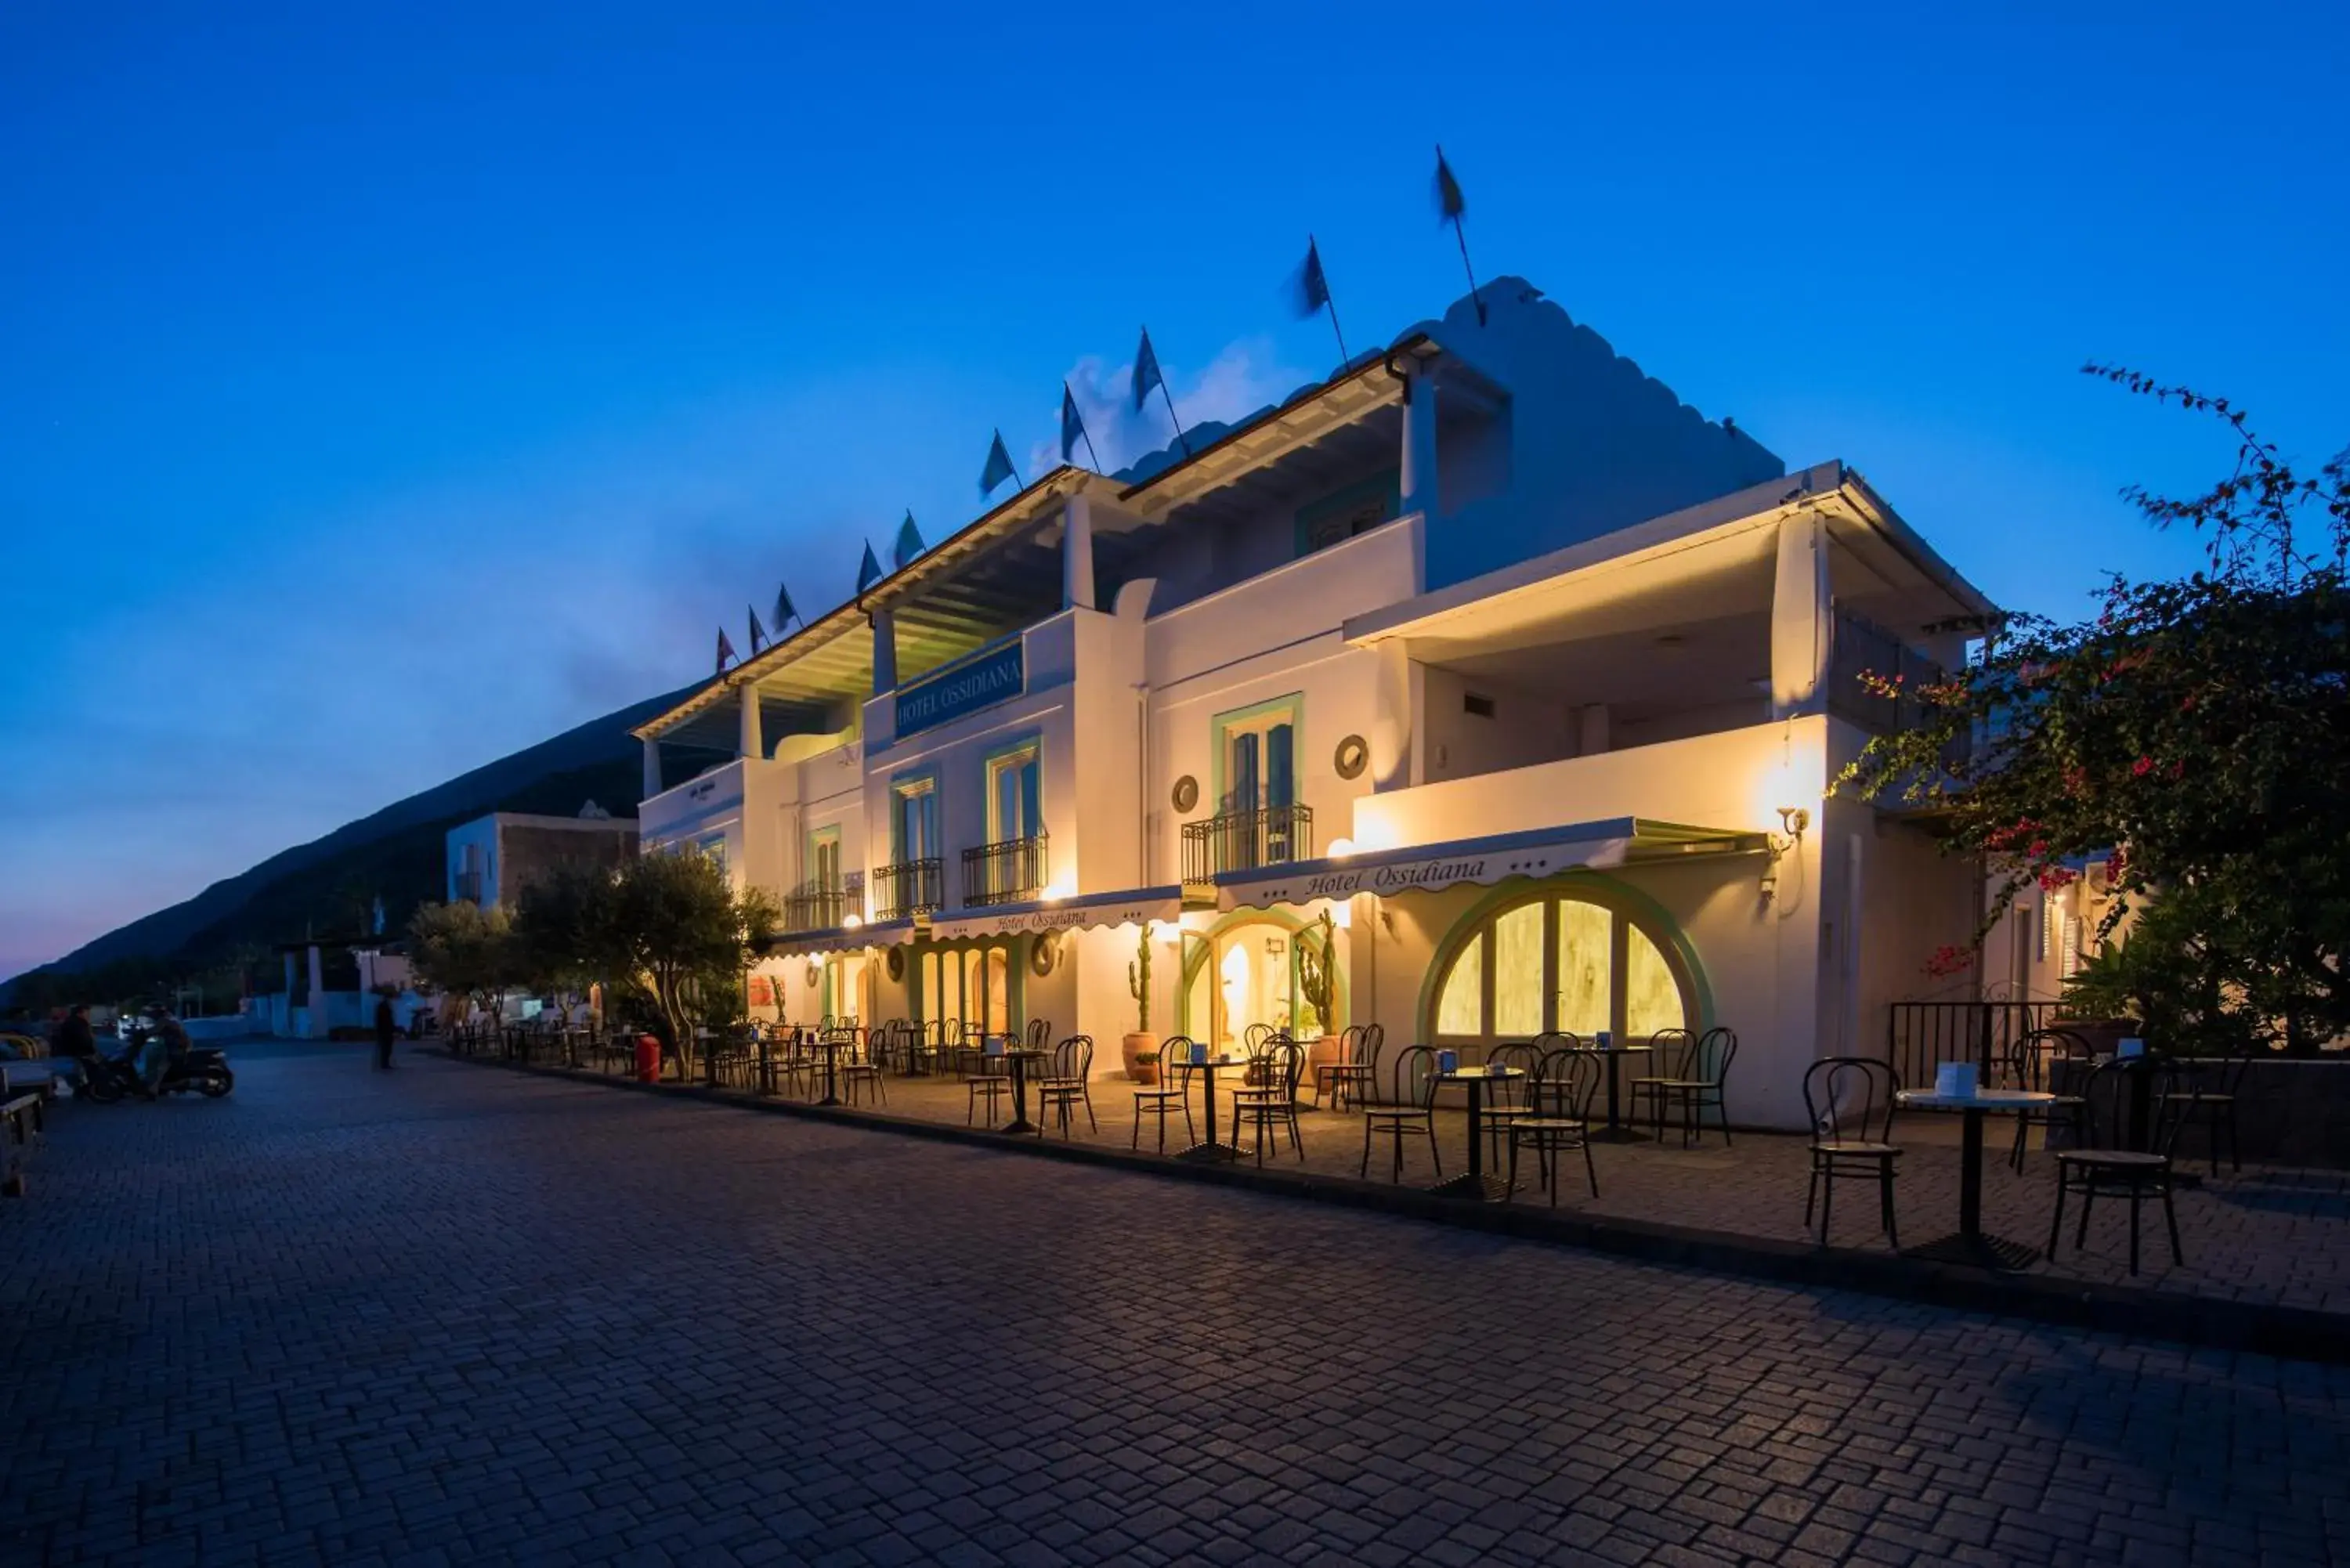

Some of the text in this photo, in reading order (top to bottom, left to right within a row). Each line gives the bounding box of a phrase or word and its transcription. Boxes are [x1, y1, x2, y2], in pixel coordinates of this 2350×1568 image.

[898, 659, 1021, 726] HOTEL OSSIDIANA
[1304, 860, 1485, 895] Hotel Ossidiana
[995, 915, 1026, 931] Hotel
